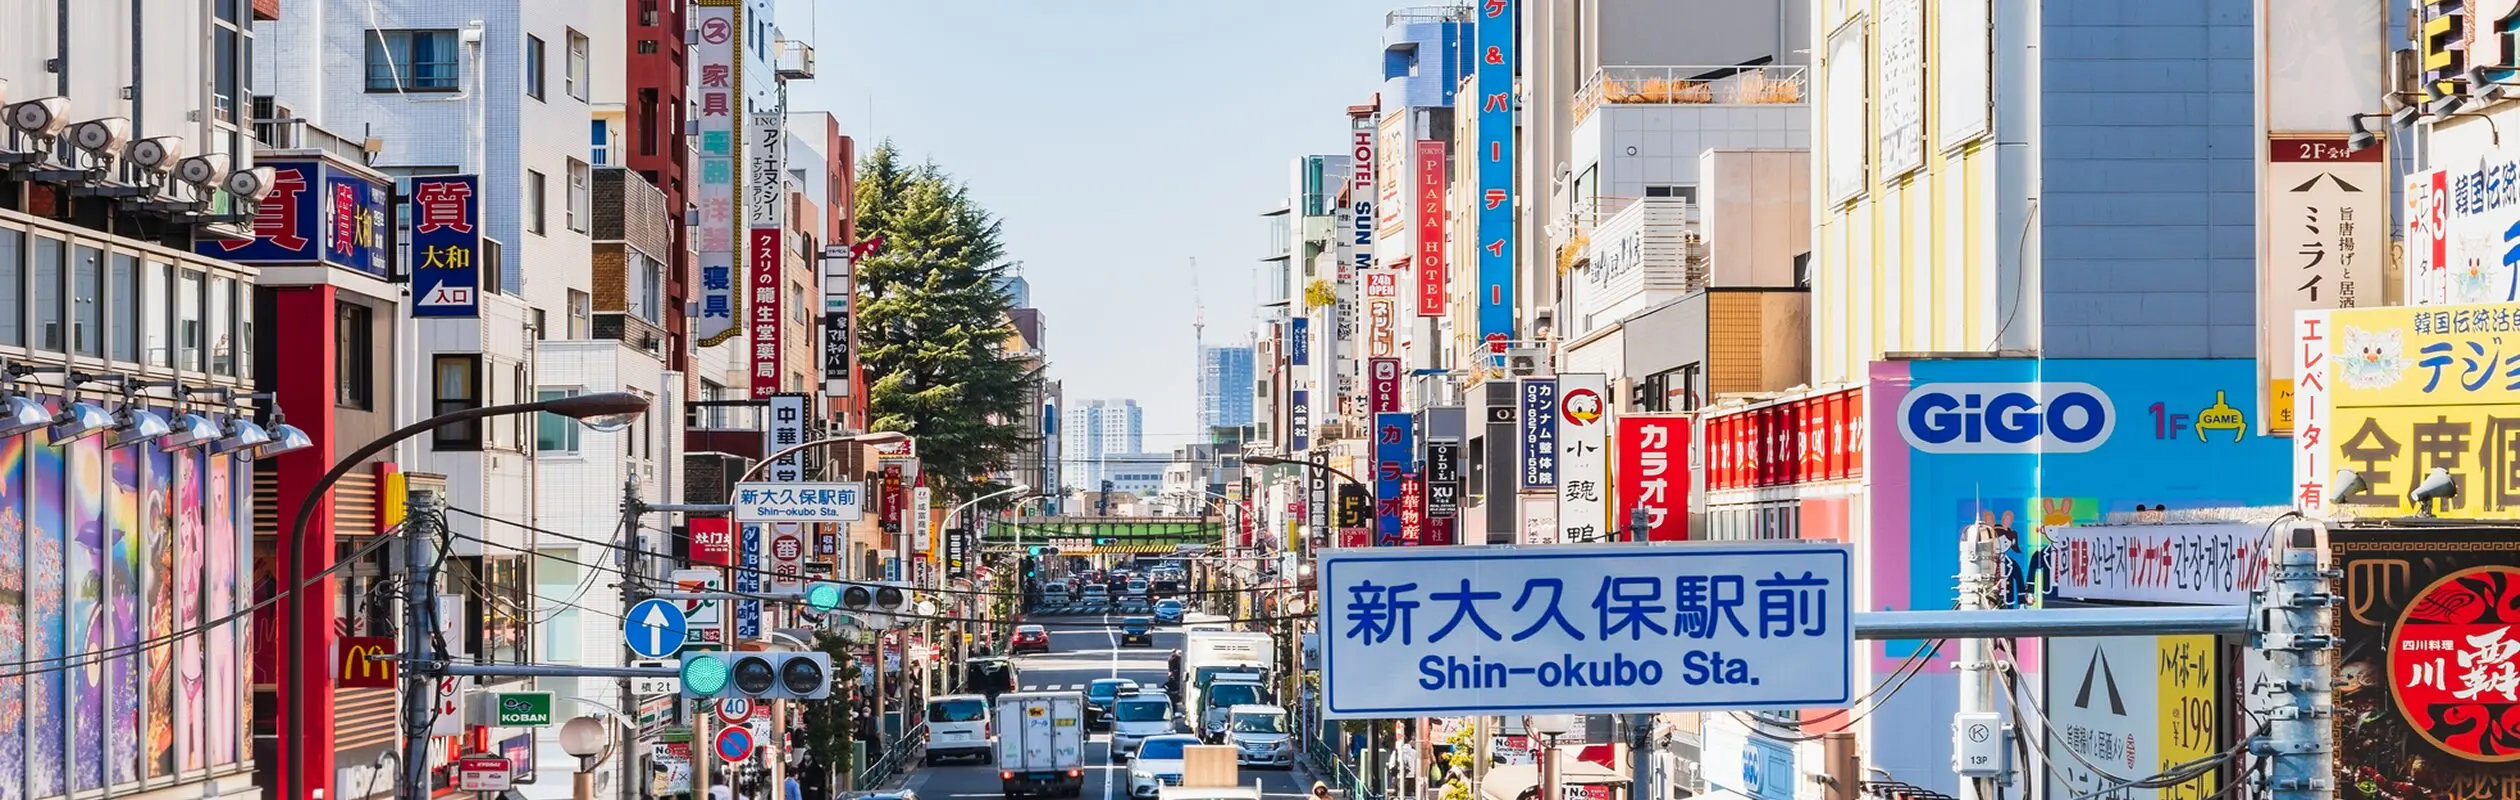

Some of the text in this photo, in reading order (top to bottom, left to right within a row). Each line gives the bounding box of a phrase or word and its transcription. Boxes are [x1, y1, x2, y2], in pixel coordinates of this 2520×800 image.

[702, 64, 730, 118] 家具
[754, 117, 777, 127] INC
[1355, 133, 1371, 190] HOTEL
[416, 182, 473, 234] 質
[753, 157, 763, 222] エンジニアリング
[355, 204, 372, 249] 大和
[1355, 202, 1371, 245] SUN
[1426, 160, 1438, 309] PLAZA HOTEL
[420, 245, 470, 270] 大和
[2297, 206, 2325, 302] ミライ
[434, 289, 467, 304] 入口
[703, 266, 730, 319] 寝具
[1368, 286, 1394, 296] OPEN
[1539, 384, 1553, 484] カンナム整体院
[2203, 414, 2239, 425] GAME
[2301, 319, 2324, 511] エレベーター有
[740, 488, 856, 506] 新大久保駅前
[1640, 424, 1668, 530] カラオケ
[757, 507, 840, 516] Shin-okubo Sta.
[1400, 479, 1420, 539] 中華物産
[1346, 572, 1830, 646] 新大久保駅前
[2160, 642, 2210, 688] ハイボール
[2402, 640, 2454, 651] 四川料理
[1418, 651, 1760, 691] Shin-okubo Sta.
[501, 713, 547, 722] KOBAN
[724, 699, 746, 715] 40
[1970, 756, 1988, 765] 13P
